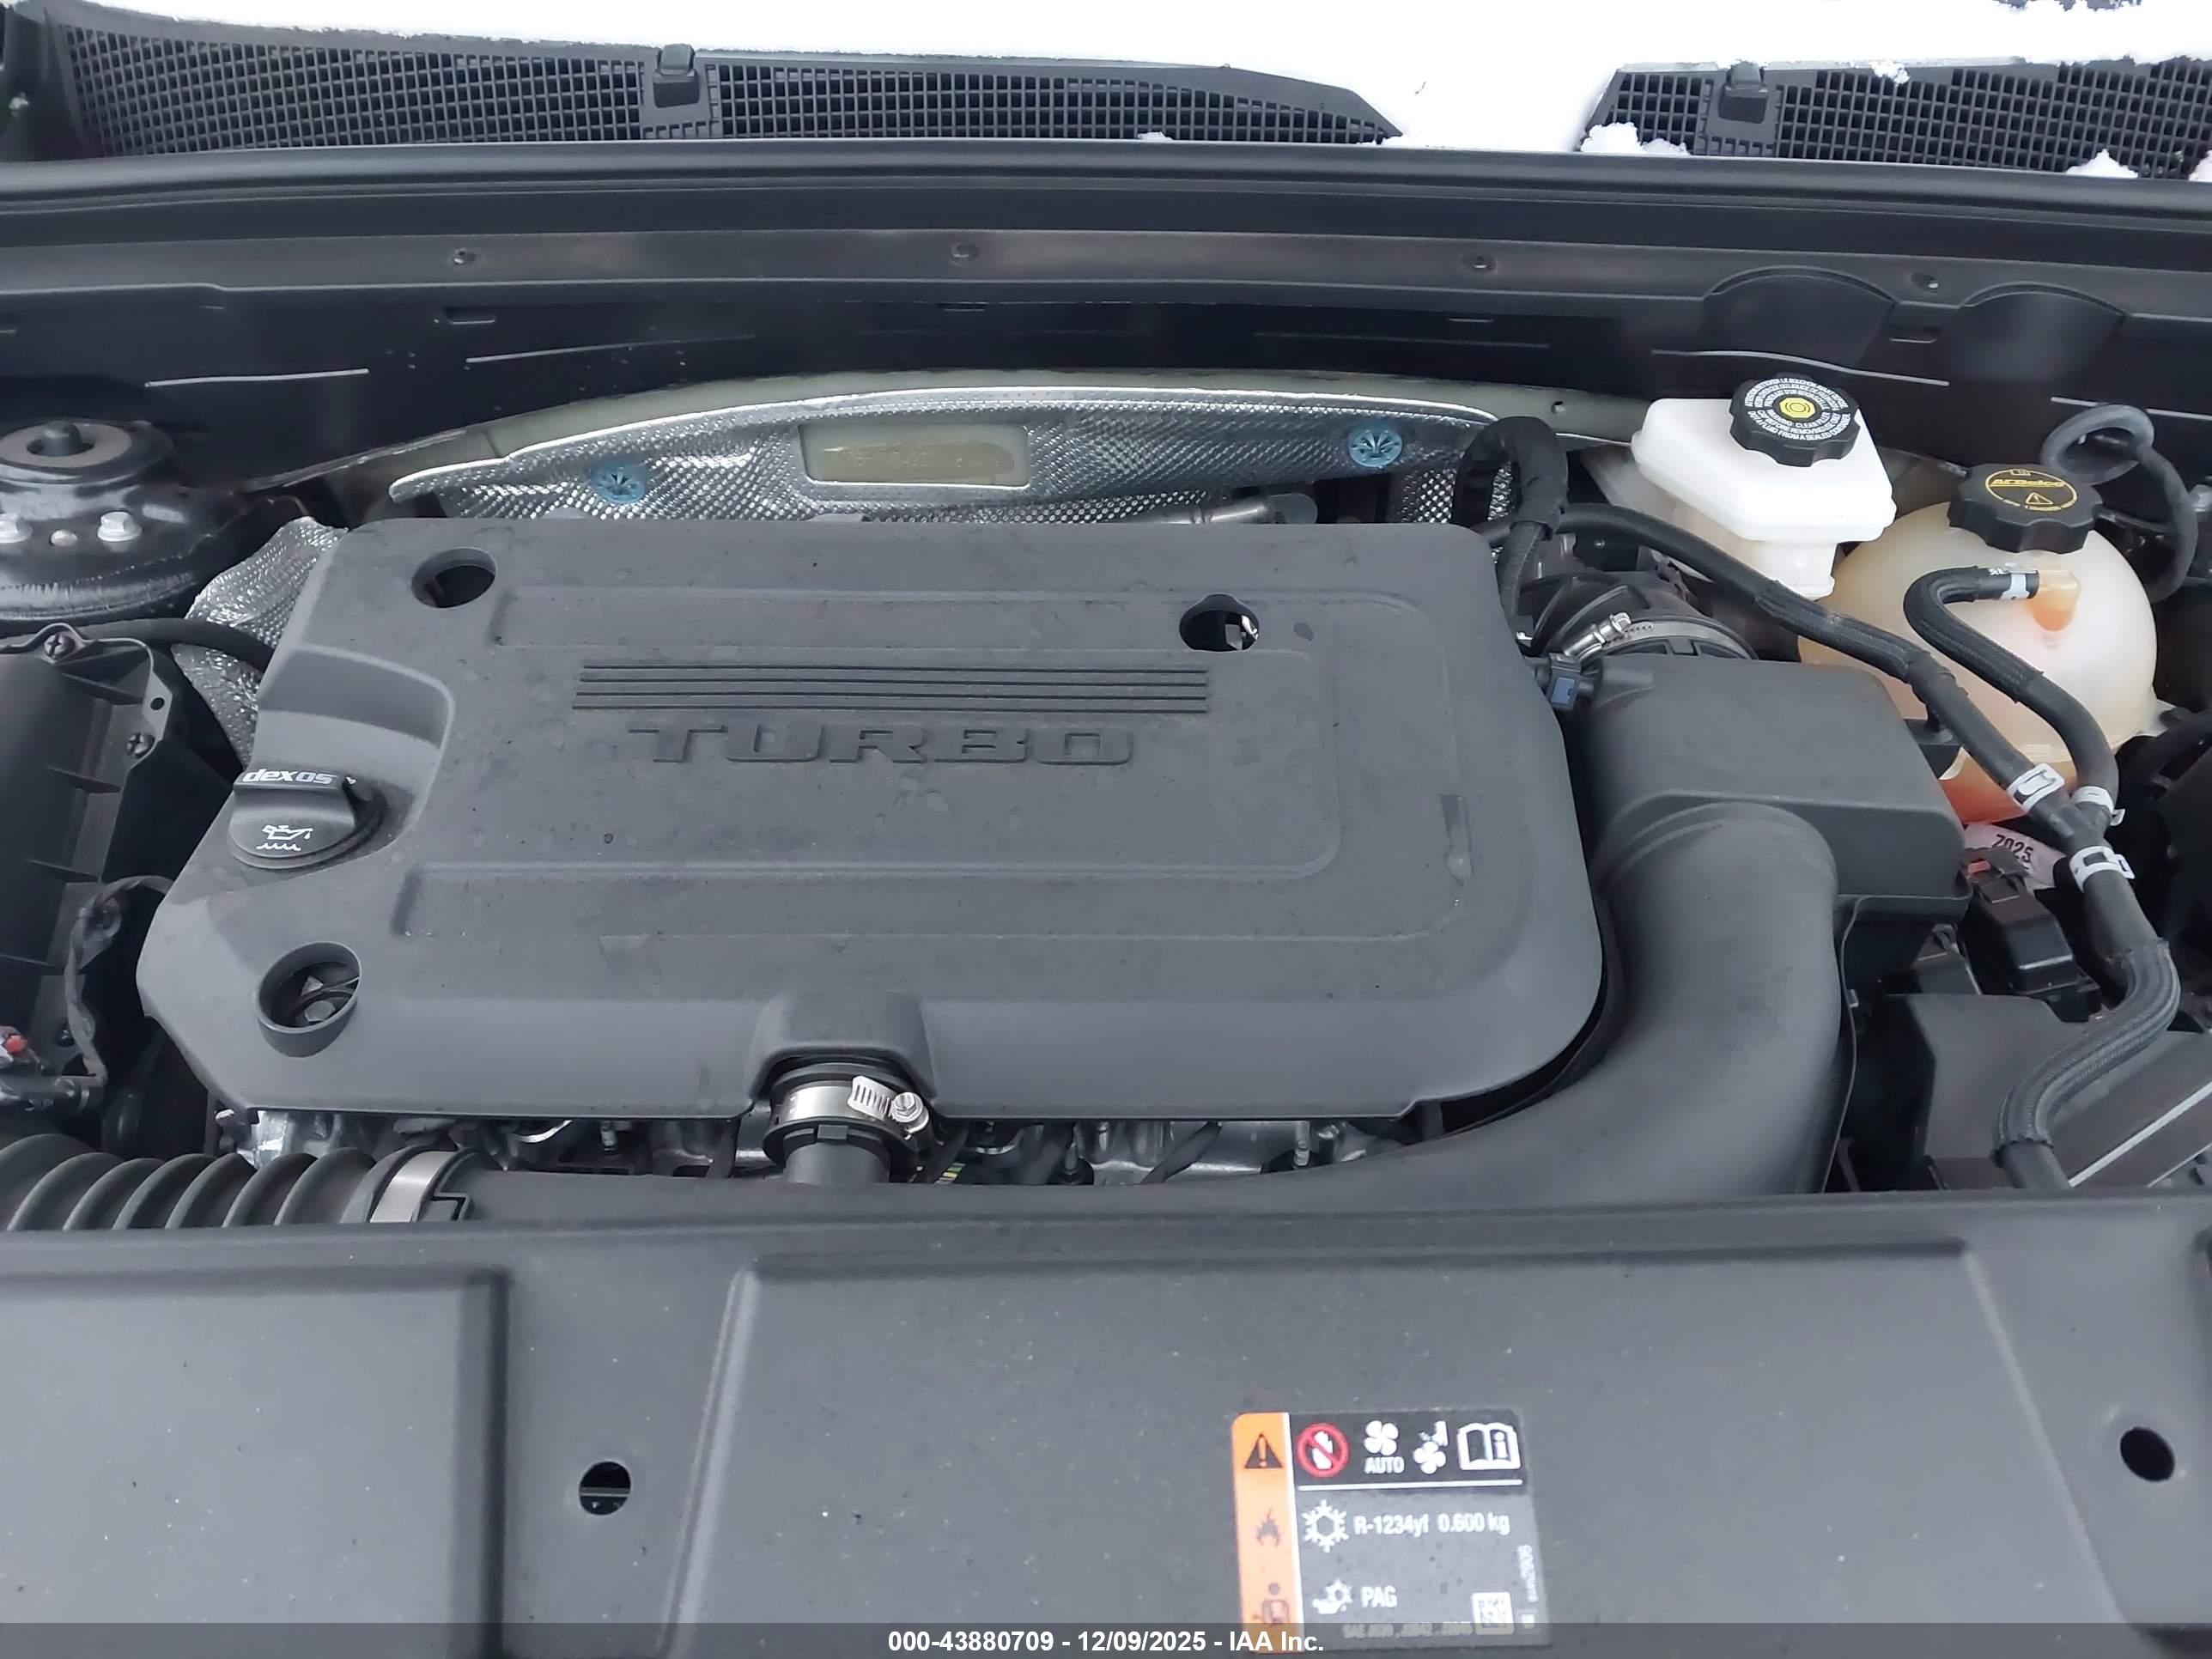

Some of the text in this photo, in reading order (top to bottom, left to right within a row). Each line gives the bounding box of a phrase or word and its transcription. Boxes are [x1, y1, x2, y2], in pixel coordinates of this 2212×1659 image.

[1778, 430, 1800, 440] FROM
[629, 724, 1133, 766] TURBO
[242, 769, 338, 785] dexos
[1364, 1456, 1405, 1474] AUTO
[1353, 1512, 1510, 1538] R-1234yf 0.600 kg
[1361, 1585, 1398, 1607] PAG
